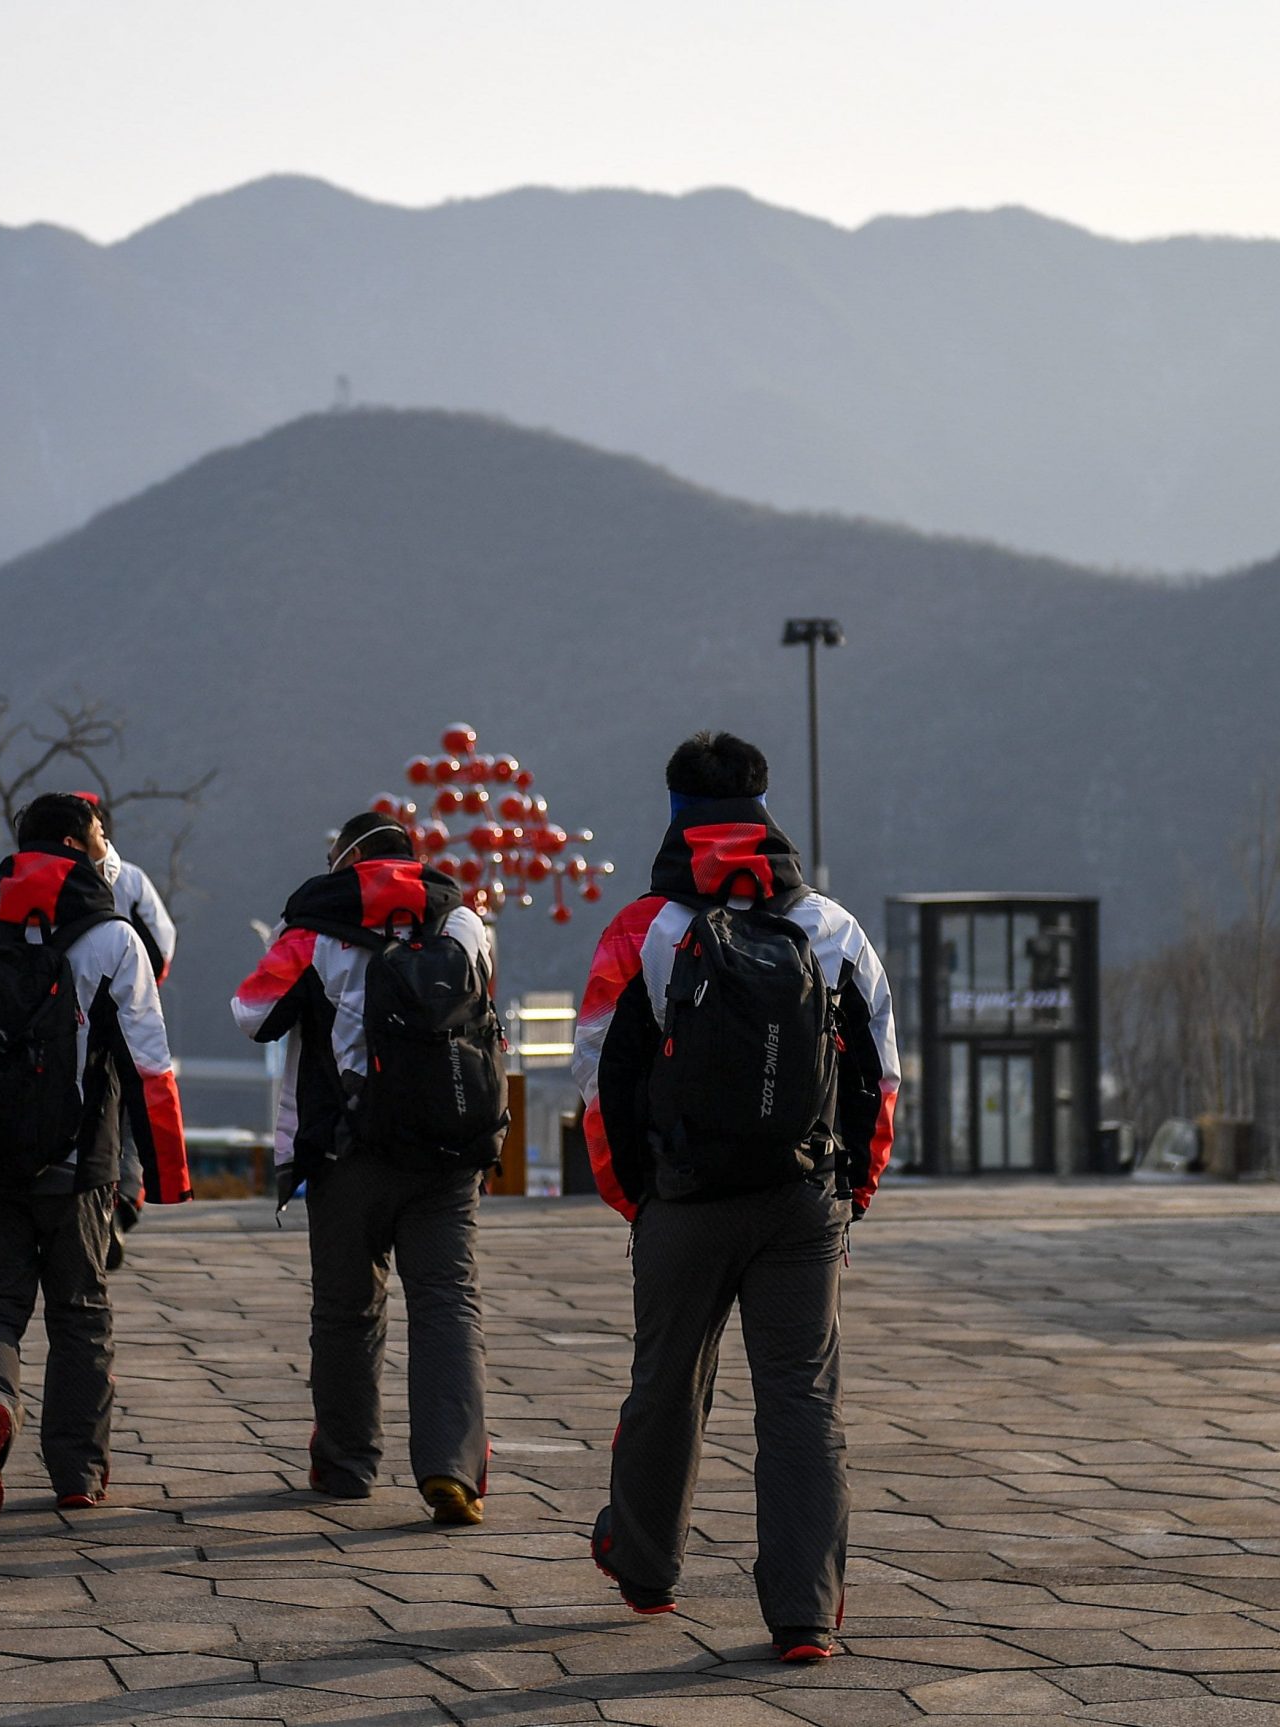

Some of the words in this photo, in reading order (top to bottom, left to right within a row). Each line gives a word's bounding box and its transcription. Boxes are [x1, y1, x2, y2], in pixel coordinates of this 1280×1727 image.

[449, 1038, 463, 1081] BEIJING
[764, 1023, 780, 1076] BEIJING
[454, 1083, 467, 1116] 2022
[760, 1078, 775, 1119] 2022
